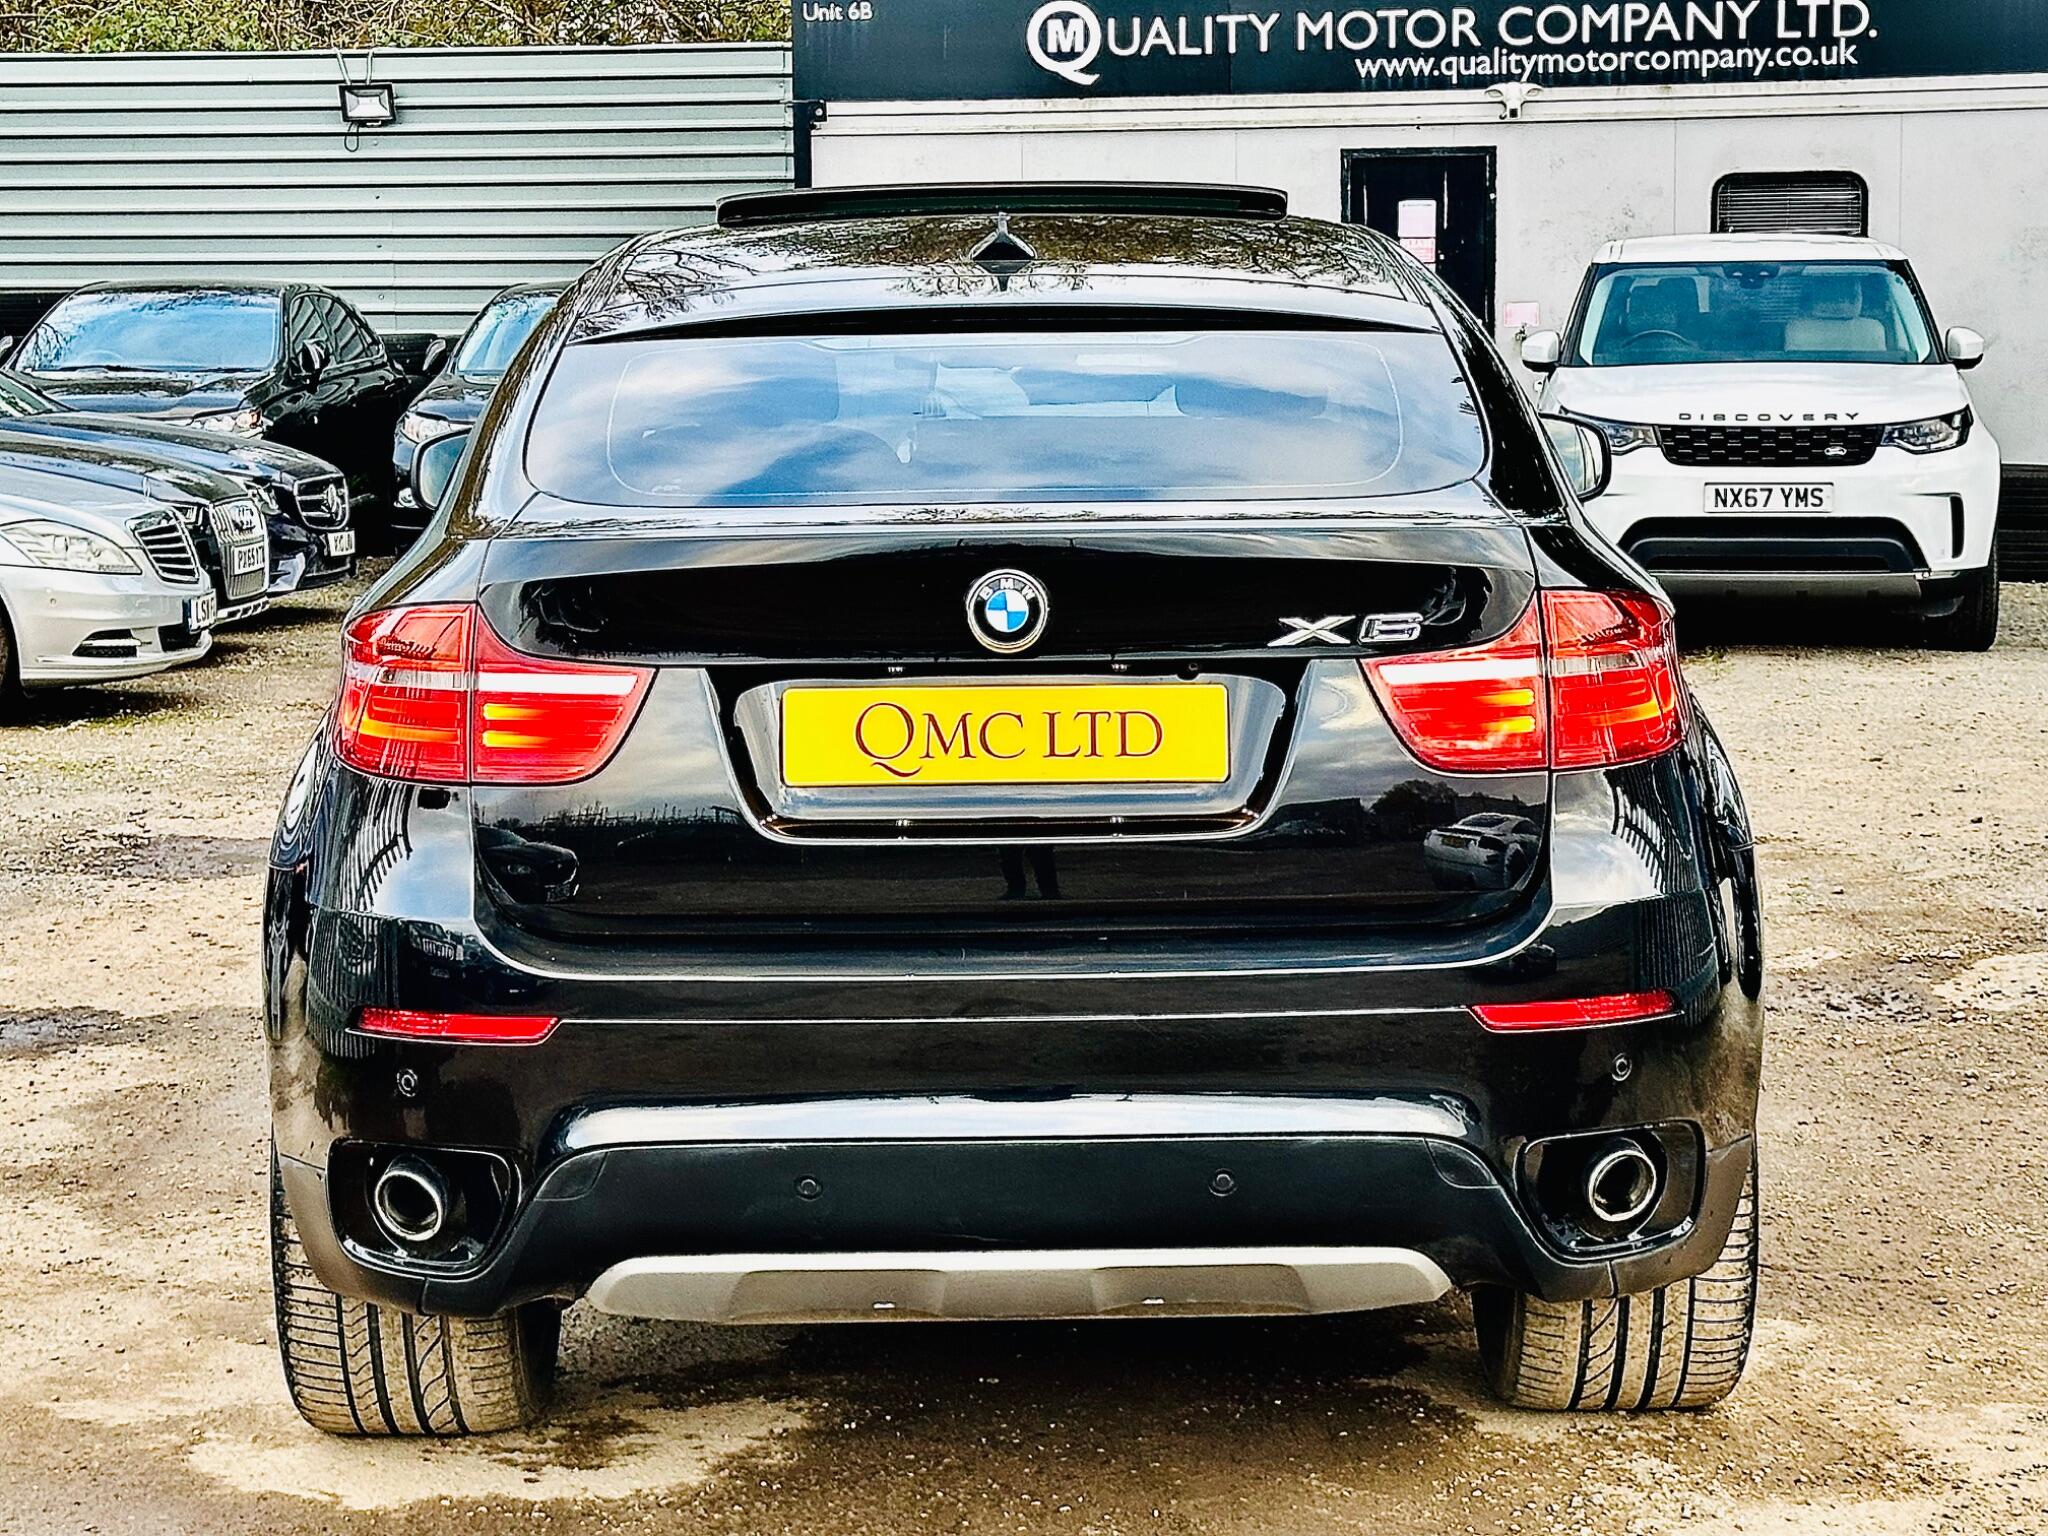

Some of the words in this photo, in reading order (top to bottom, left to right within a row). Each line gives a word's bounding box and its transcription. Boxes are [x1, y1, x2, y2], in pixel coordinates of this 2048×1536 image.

[802, 2, 843, 21] Unit
[847, 2, 873, 20] 6B
[1297, 8, 1482, 51] MOTOR
[1499, 0, 1758, 46] COMPANY
[1777, 0, 1878, 40] LTD.
[1355, 37, 1858, 85] www.qualitymotorcompany.co.uk
[1678, 411, 1860, 422] DISCOVERY
[1713, 487, 1771, 509] NX67
[1779, 487, 1825, 508] YMS
[979, 577, 1036, 601] BMW
[1267, 612, 1424, 647] X6
[854, 701, 1025, 778] QMC
[1042, 710, 1163, 759] LTD
